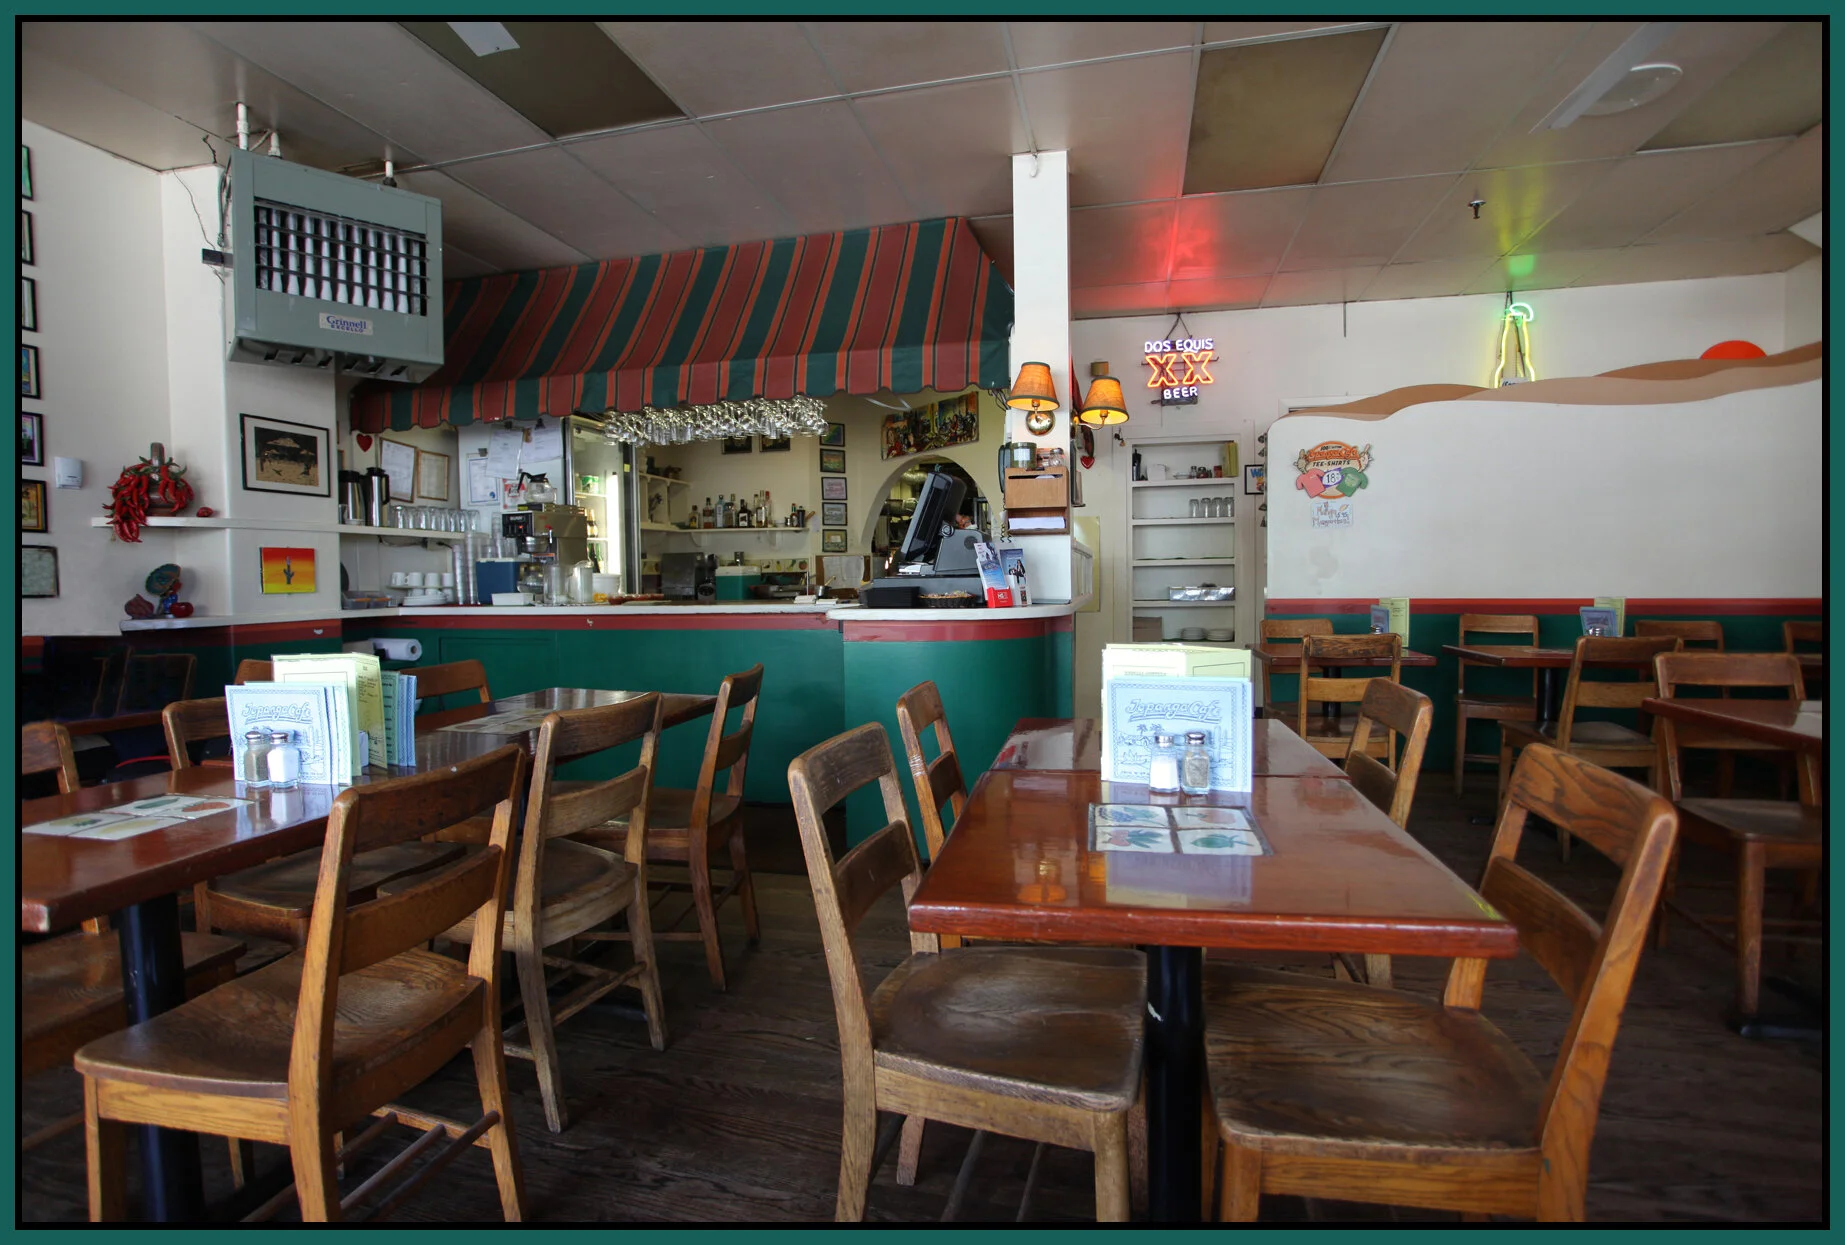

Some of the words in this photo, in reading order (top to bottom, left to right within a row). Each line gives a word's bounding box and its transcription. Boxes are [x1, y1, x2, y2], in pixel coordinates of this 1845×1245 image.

[326, 315, 367, 330] Grinnell
[1144, 340, 1171, 353] DOS
[1175, 338, 1214, 353] EQUIS
[1163, 386, 1198, 399] BEER
[242, 702, 288, 720] Topanga
[1125, 699, 1188, 720] Topanga
